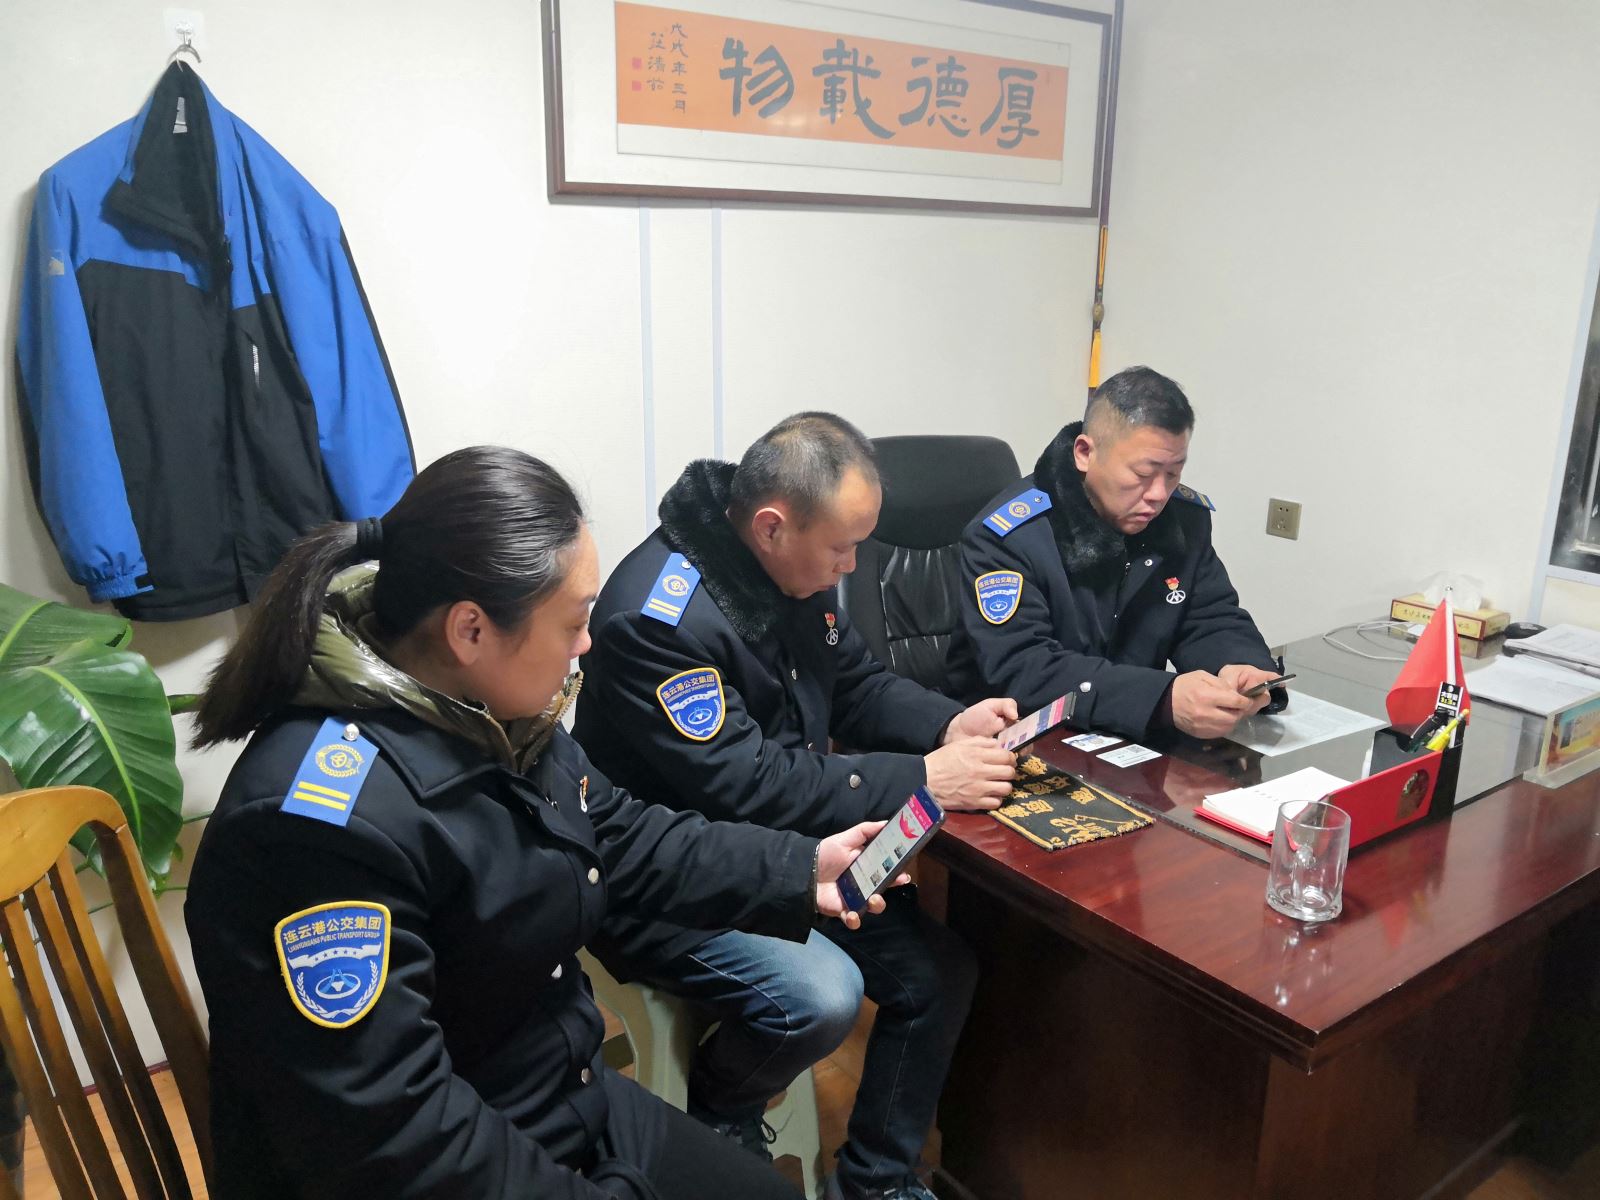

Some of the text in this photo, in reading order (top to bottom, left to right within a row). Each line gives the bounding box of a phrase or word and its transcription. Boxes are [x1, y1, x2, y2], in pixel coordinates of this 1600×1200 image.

[283, 916, 381, 945] 连云港公交集团
